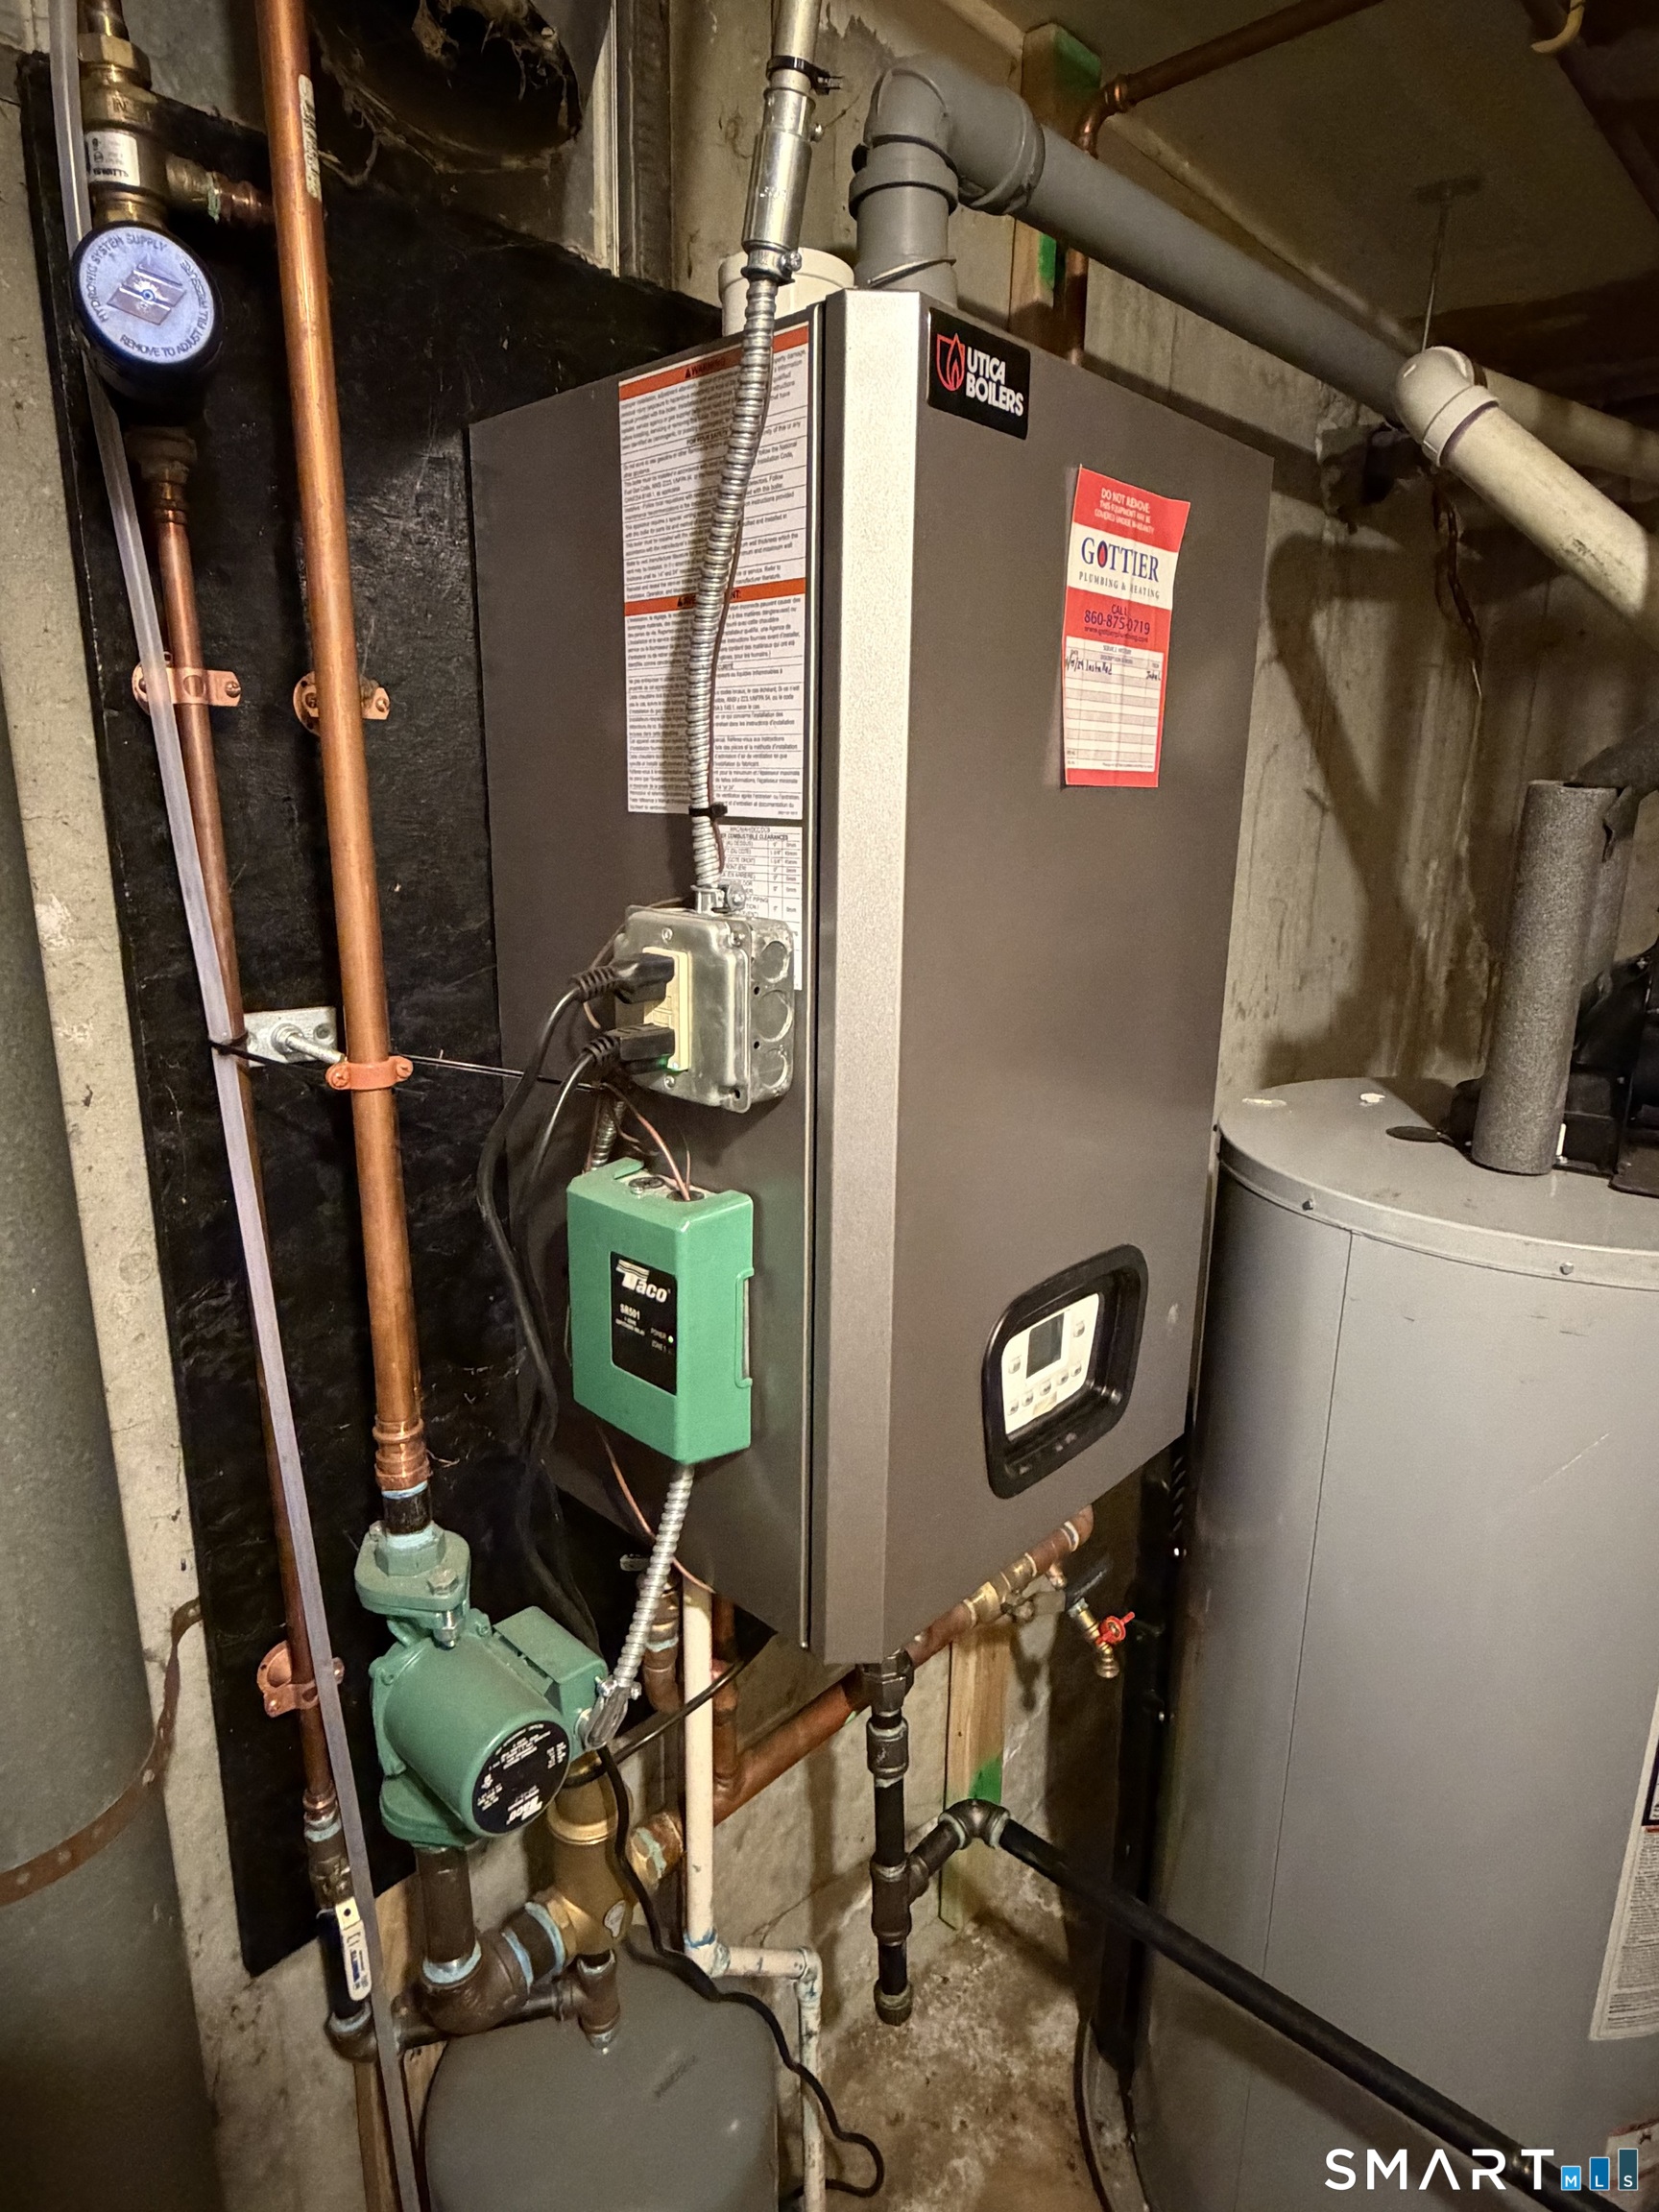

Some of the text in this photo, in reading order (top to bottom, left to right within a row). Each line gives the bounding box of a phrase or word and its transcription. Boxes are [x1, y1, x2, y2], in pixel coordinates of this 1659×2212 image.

[85, 233, 167, 324] HYDRONIC SYSTEM SUPPLY
[120, 334, 160, 357] REMOVE
[160, 347, 177, 358] TO
[177, 330, 204, 354] ADJUST
[967, 347, 1006, 385] UTICA
[965, 372, 1024, 417] BOILERS
[1101, 487, 1151, 515] DO NOT REMOVE
[1081, 537, 1159, 583] GOTTIER
[1079, 571, 1118, 589] PLUMBING
[1130, 583, 1160, 600] HEATING
[1084, 609, 1151, 636] 860-875-0719
[1111, 604, 1127, 615] CALL
[615, 1259, 668, 1303] Taco
